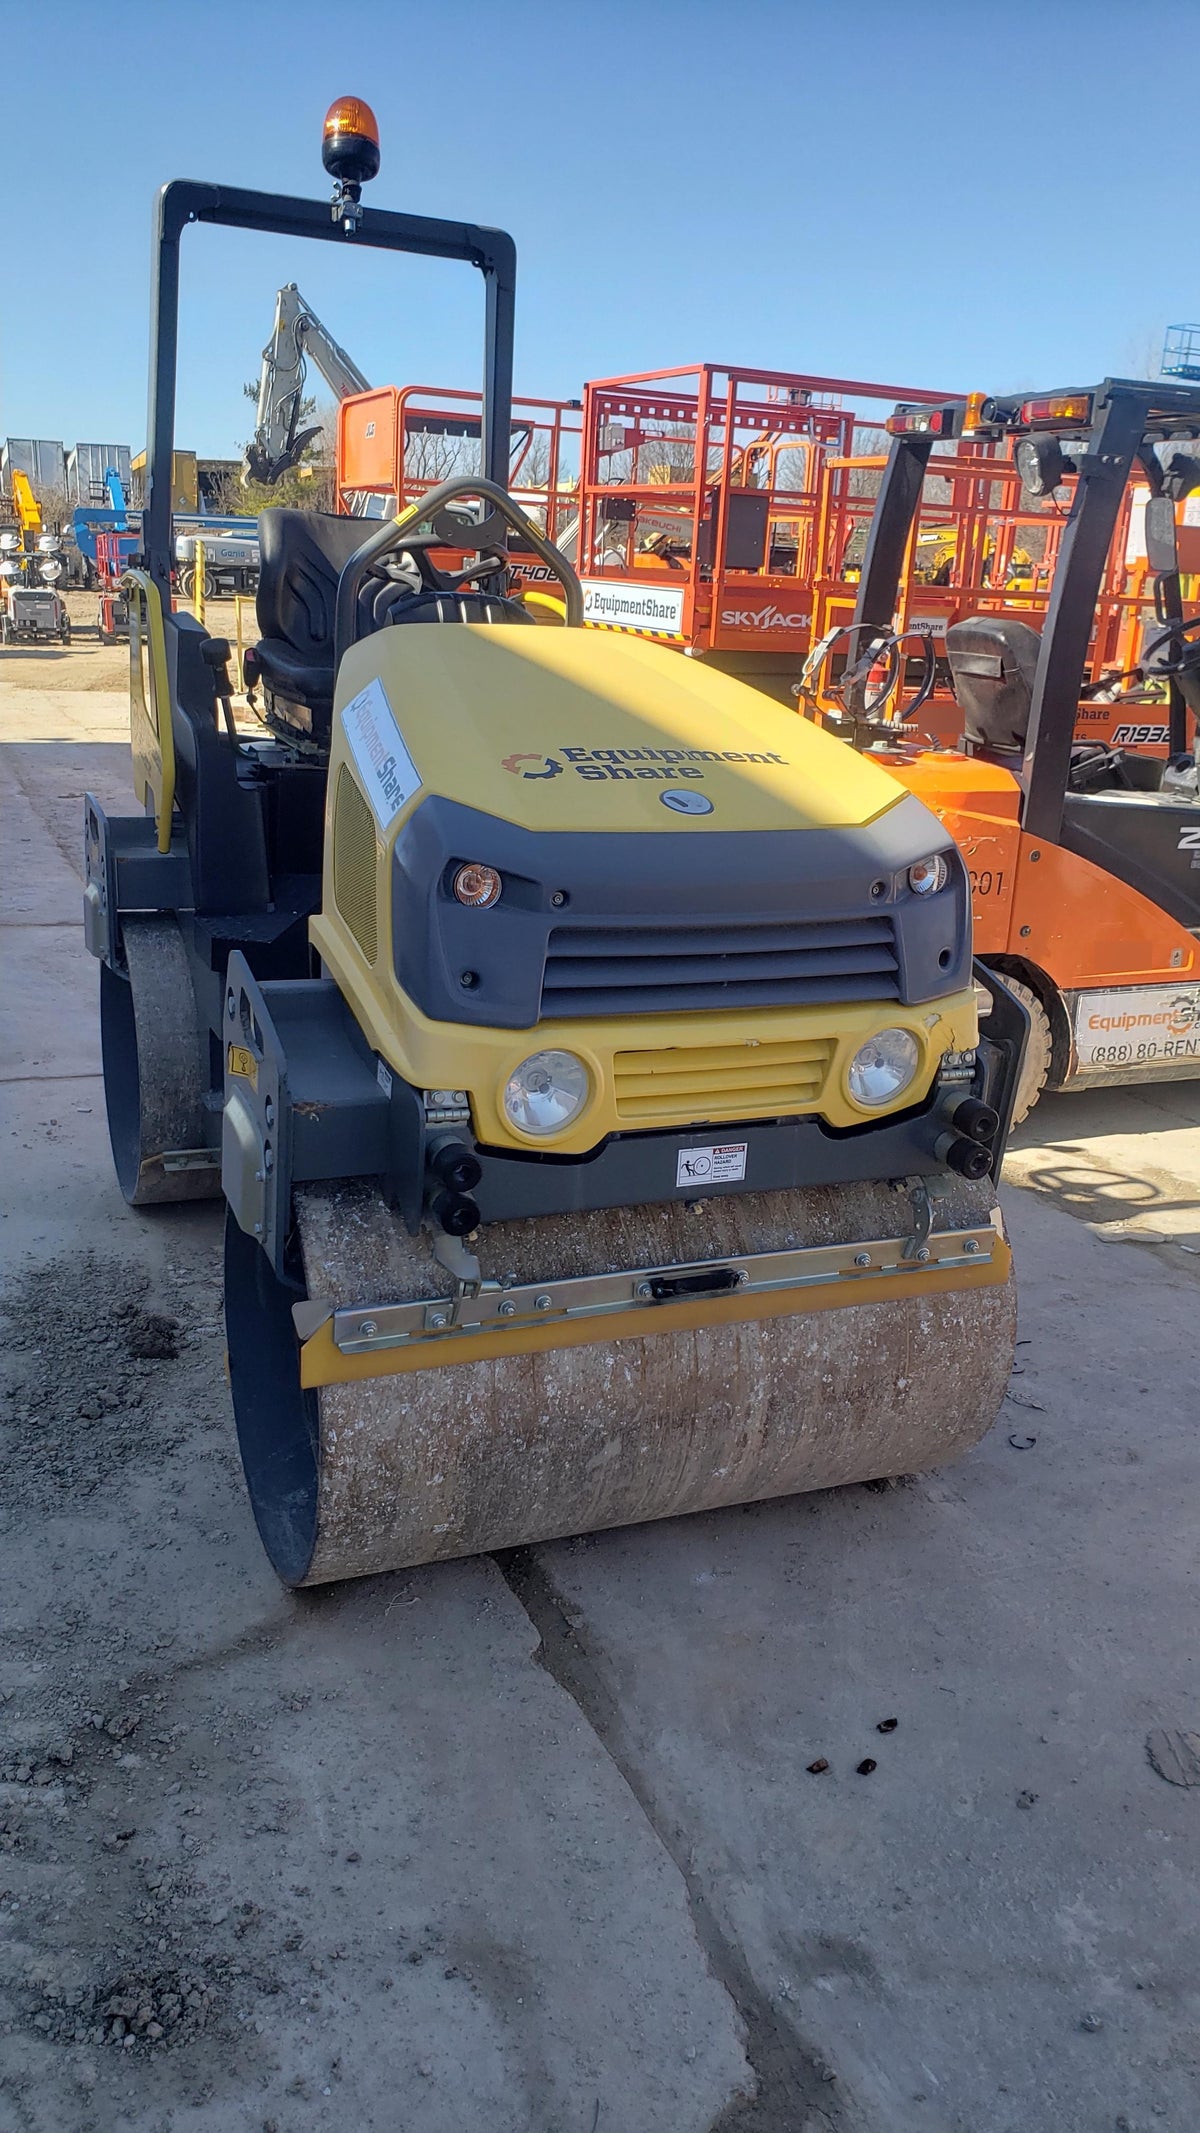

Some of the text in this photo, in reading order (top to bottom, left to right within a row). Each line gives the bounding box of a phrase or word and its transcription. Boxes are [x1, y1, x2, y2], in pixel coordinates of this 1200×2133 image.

[594, 592, 677, 620] EquipmentShare
[721, 605, 812, 630] SKYJACK
[354, 699, 405, 813] EquipmentShare
[559, 746, 790, 765] Equipment
[575, 764, 705, 781] Share
[1091, 1038, 1200, 1064] (888) 80-REN
